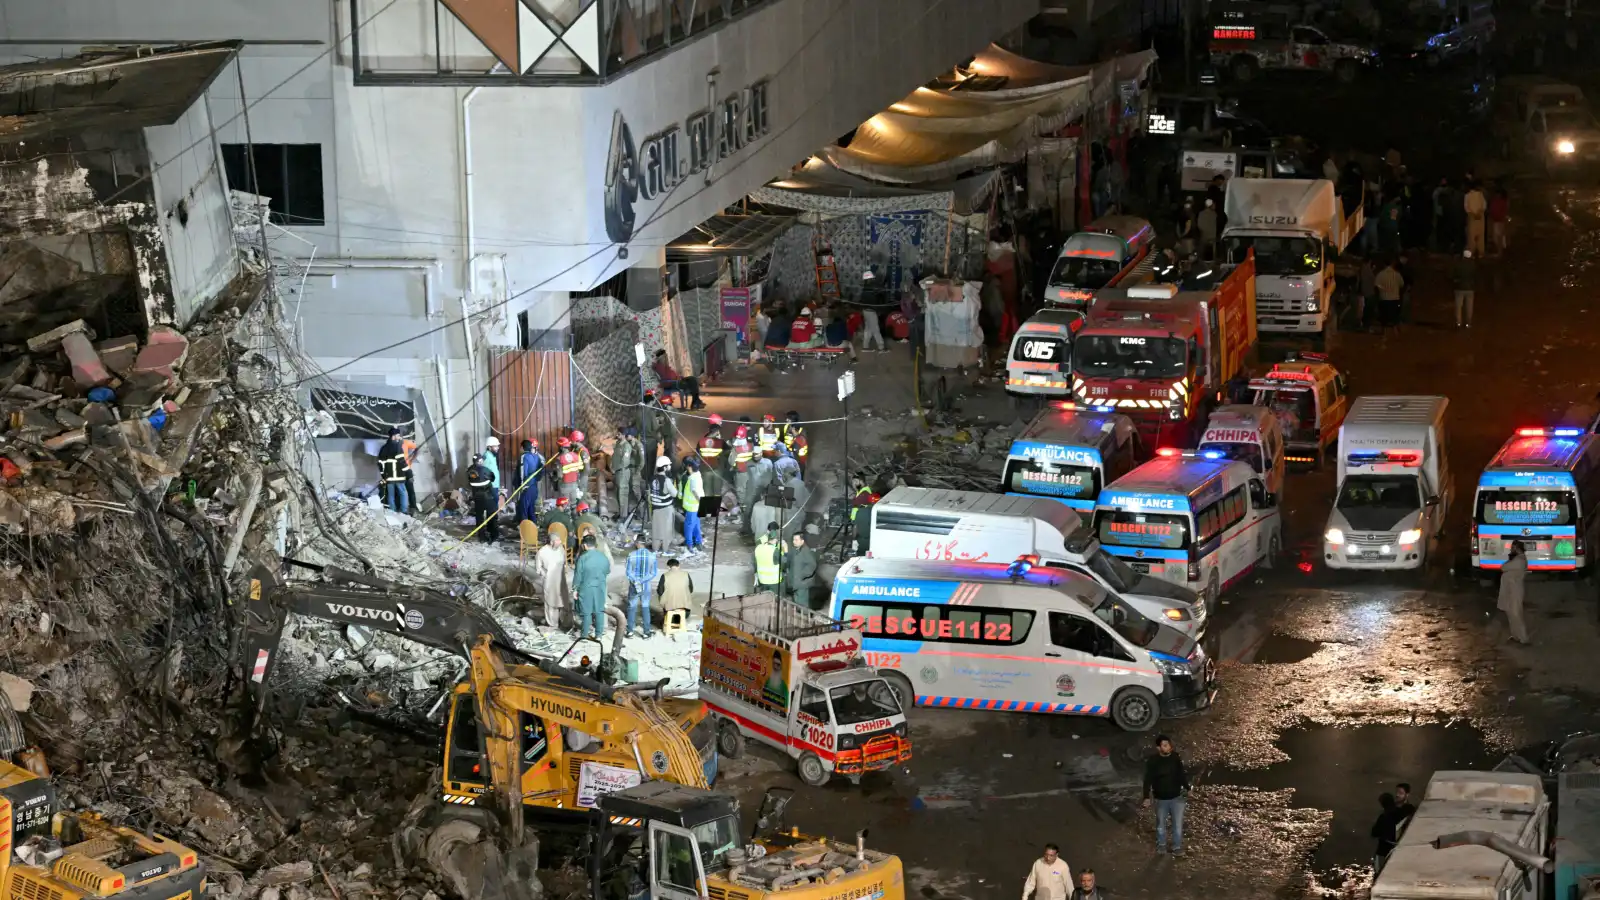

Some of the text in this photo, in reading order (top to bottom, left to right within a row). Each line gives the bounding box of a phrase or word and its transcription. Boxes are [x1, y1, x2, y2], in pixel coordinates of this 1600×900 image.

[1248, 215, 1298, 225] ISUZU
[1120, 337, 1146, 345] KMC
[1150, 389, 1168, 397] FIRE
[1206, 429, 1258, 442] CHHIPA
[1023, 447, 1092, 463] AMBULANCE
[1023, 470, 1082, 485] RESCUE 1122
[1495, 501, 1557, 511] RESCUE 1122
[1110, 522, 1171, 535] RESCUE 1122
[851, 585, 921, 598] AMBULANCE
[325, 602, 395, 622] VOLVO
[866, 652, 902, 669] 1122
[530, 696, 587, 723] HYUNDAI
[797, 711, 826, 728] CHHIPA
[855, 718, 893, 733] CHHIPA
[807, 727, 835, 750] 1020
[24, 795, 47, 807] VOLVO
[141, 866, 162, 878] VOLVO
